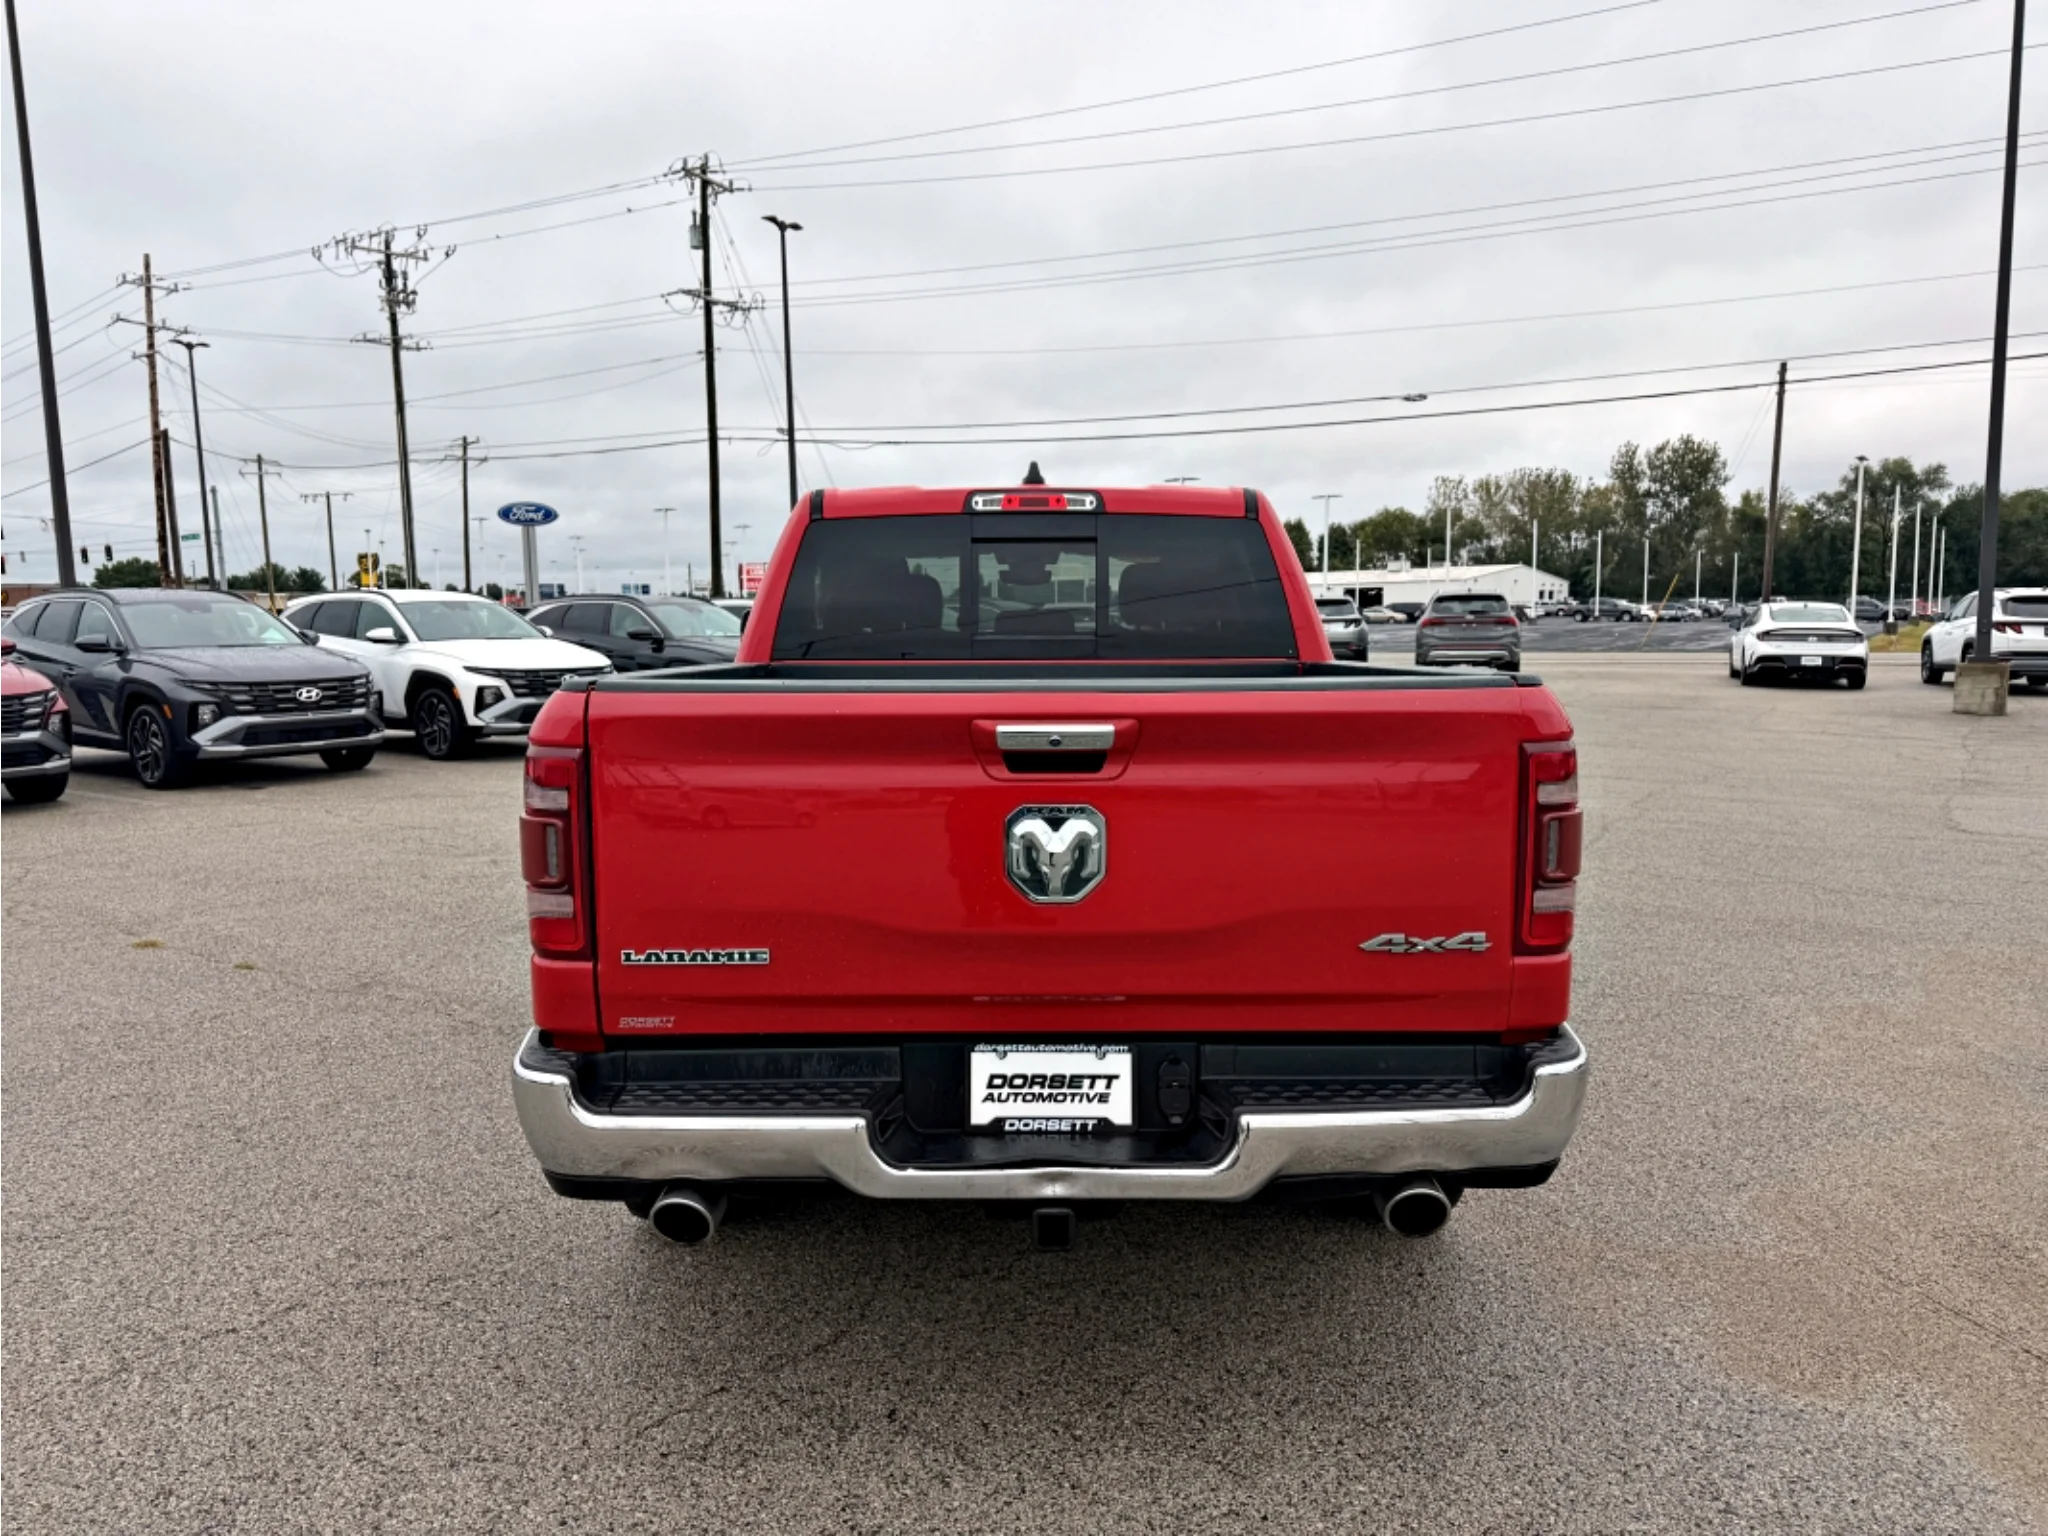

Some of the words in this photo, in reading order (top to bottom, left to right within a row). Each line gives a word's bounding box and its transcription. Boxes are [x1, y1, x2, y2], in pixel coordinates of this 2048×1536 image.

[509, 505, 545, 520] Ford
[1358, 931, 1493, 953] 4x4
[621, 948, 770, 965] LARAMIE
[986, 1073, 1120, 1090] DORSETT
[981, 1092, 1111, 1104] AUTOMOTIVE
[1003, 1119, 1098, 1132] DORSETT
